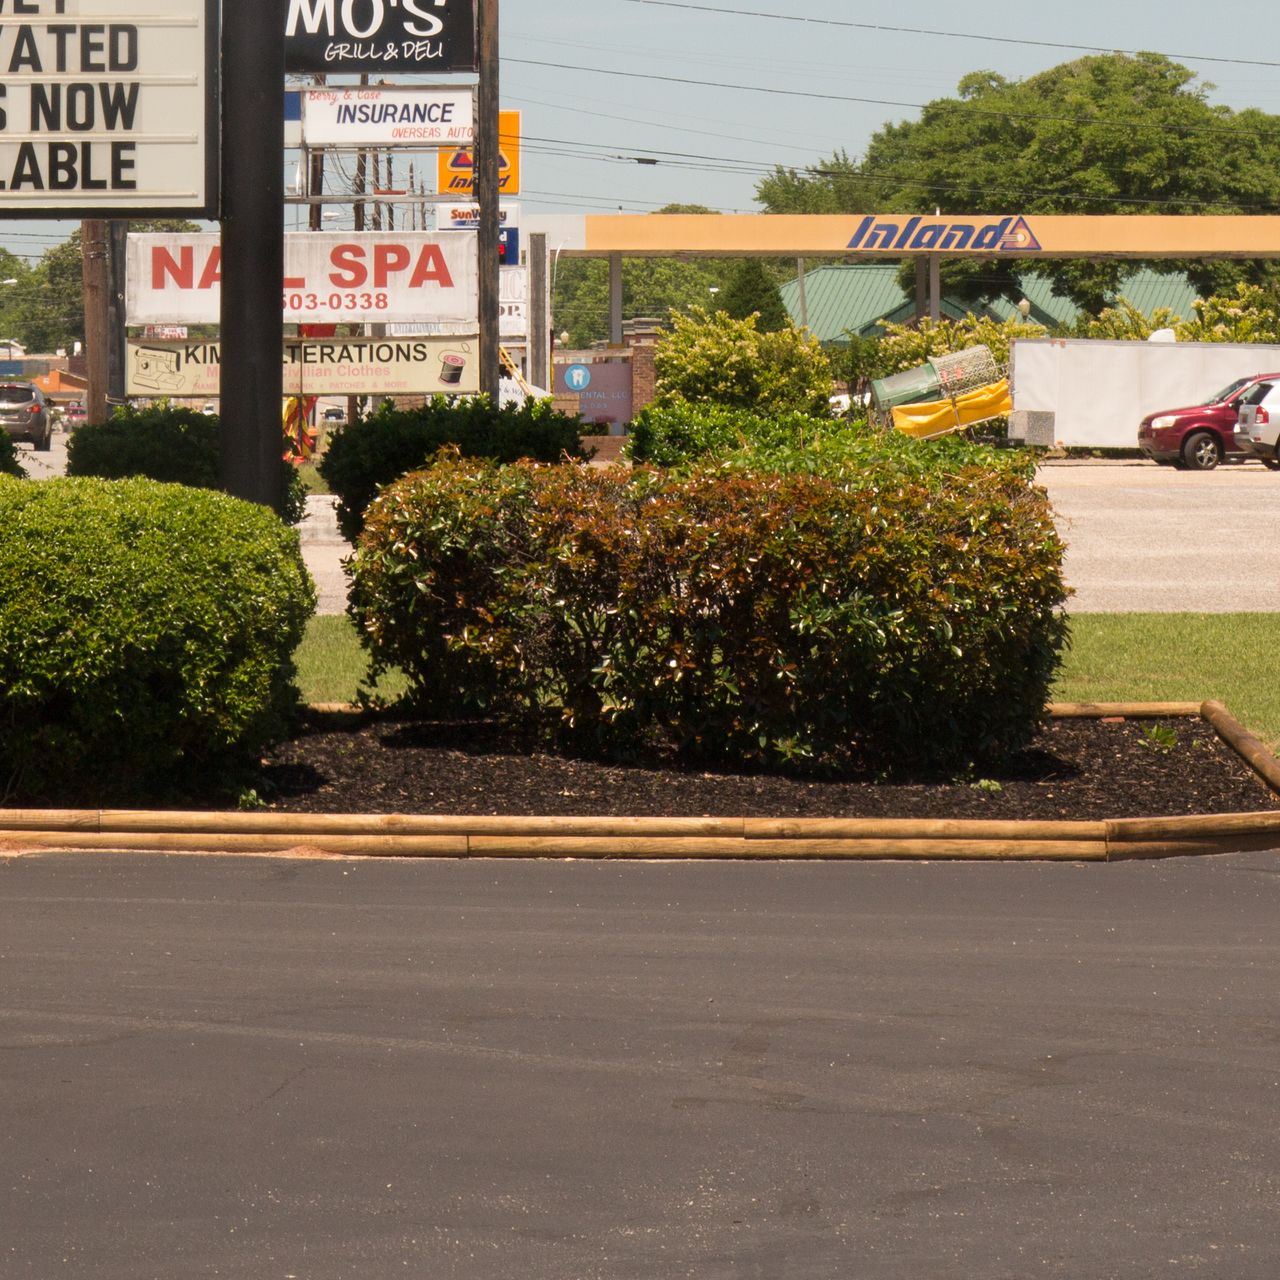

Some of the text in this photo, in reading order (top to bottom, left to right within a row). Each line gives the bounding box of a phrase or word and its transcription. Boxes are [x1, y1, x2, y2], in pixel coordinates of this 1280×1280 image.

[324, 40, 443, 61] GRILL & DELI
[30, 82, 140, 132] NOW
[336, 103, 455, 124] INSURANCE
[392, 127, 473, 138] OVERSEAS AUTO
[448, 175, 510, 189] Inld
[451, 209, 507, 222] SunVy
[846, 216, 1013, 249] Inland
[152, 245, 305, 290] NA
[328, 243, 455, 289] SPA
[283, 293, 388, 310] 03-0338
[283, 343, 427, 363] TERATIONS
[336, 365, 390, 377] Clothes
